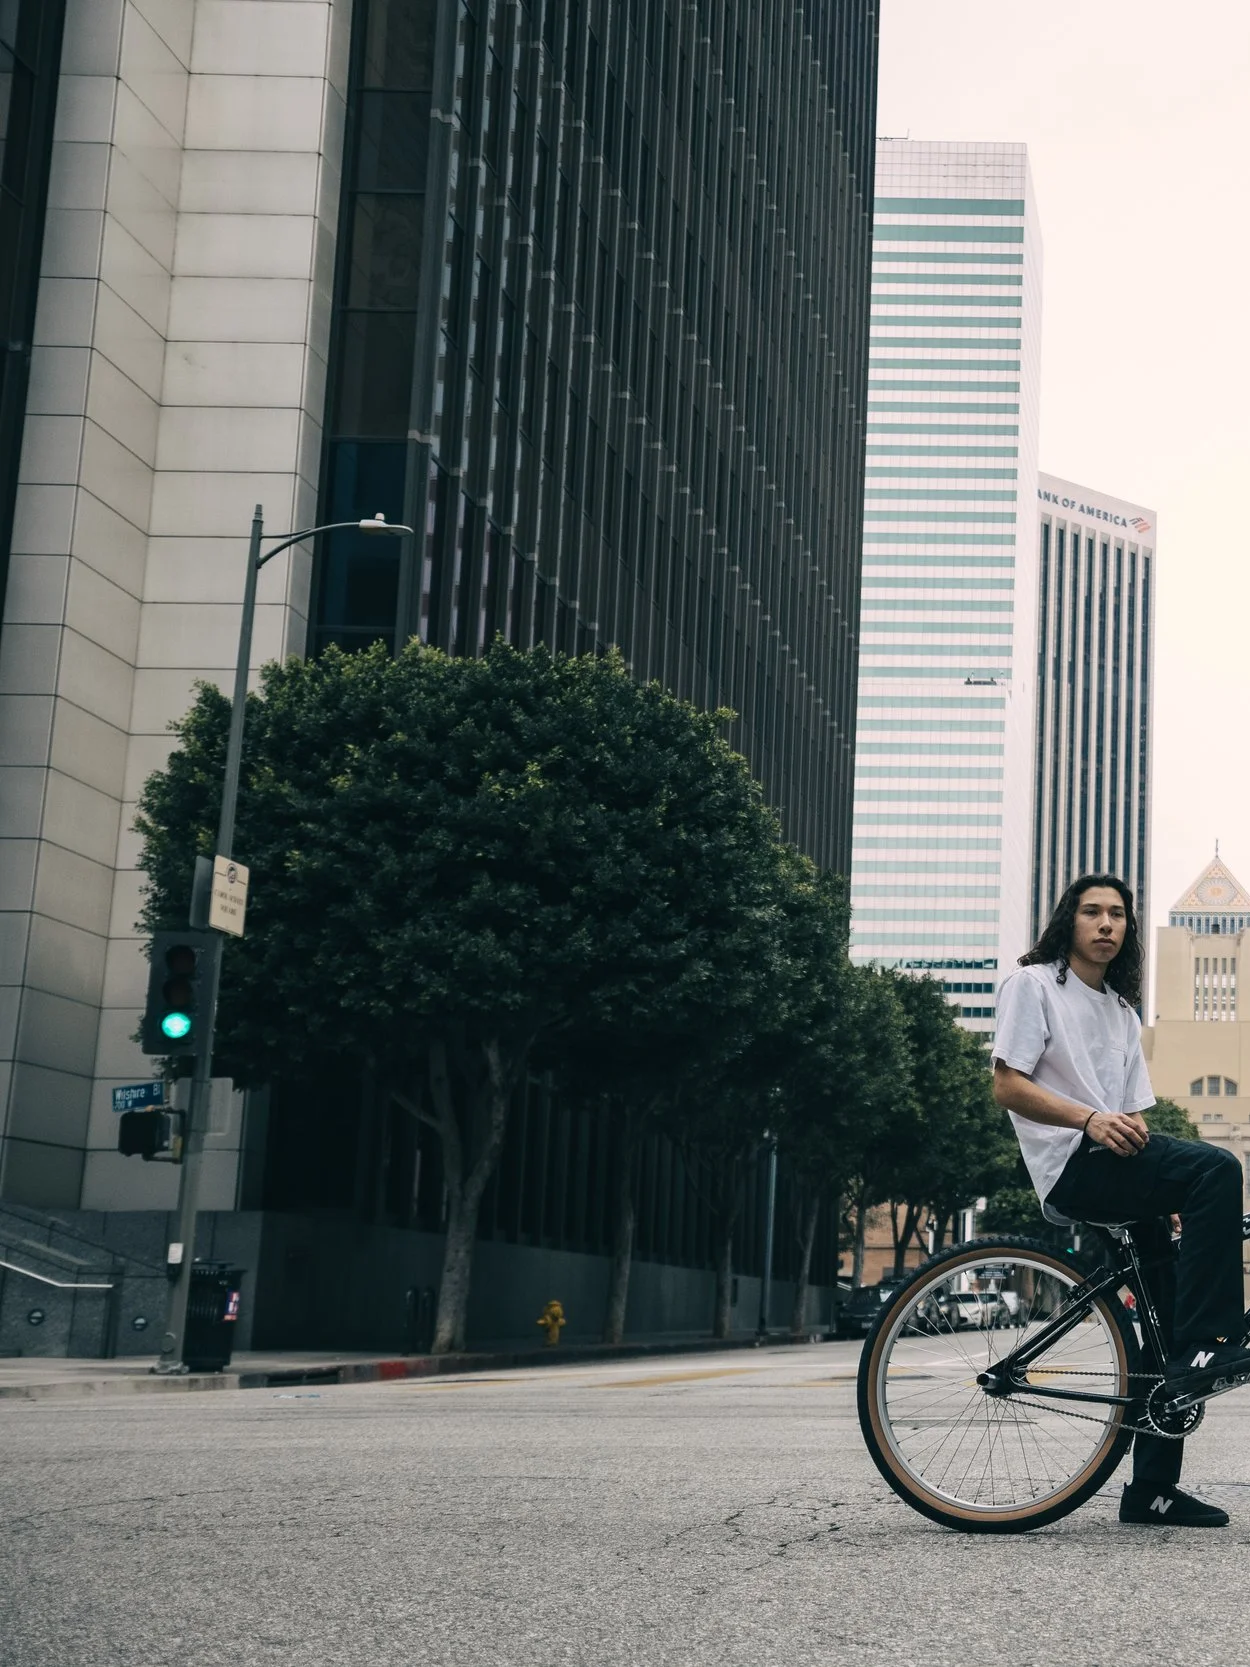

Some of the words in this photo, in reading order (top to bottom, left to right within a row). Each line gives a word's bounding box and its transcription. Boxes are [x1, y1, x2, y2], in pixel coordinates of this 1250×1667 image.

[1061, 498, 1076, 509] OF
[1078, 503, 1128, 527] AMERICA
[115, 1087, 146, 1101] Wilshire
[1190, 1350, 1215, 1368] N
[1149, 1495, 1174, 1515] N
